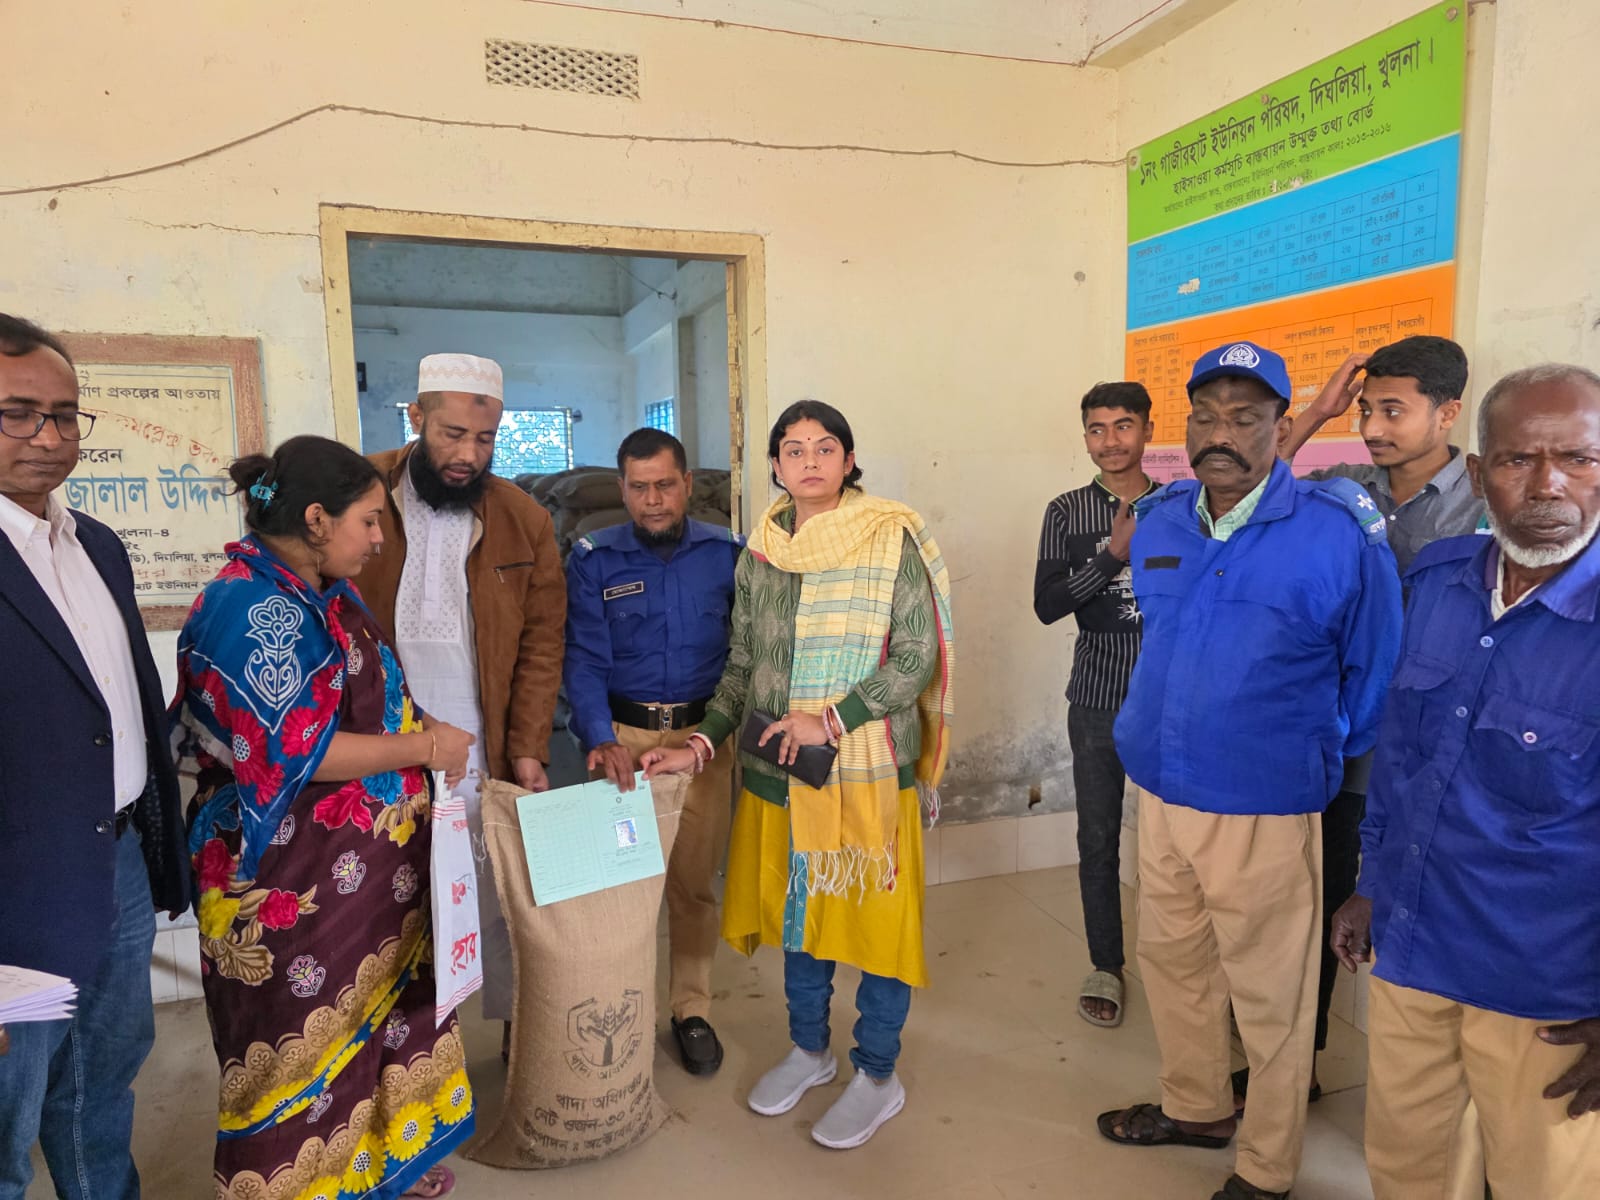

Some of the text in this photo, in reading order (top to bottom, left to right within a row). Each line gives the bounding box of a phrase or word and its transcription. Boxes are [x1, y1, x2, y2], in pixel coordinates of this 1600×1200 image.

[1160, 132, 1207, 175] গাজীরহাট
[1210, 116, 1255, 156] ইউনিয়ন
[1261, 95, 1305, 133] পরিষদ,
[1309, 64, 1372, 114] দিঘলিয়া,
[1378, 37, 1421, 89] খুলনা
[1347, 96, 1375, 127] বোর্ড
[107, 385, 160, 400] প্রকল্পের
[164, 387, 221, 401] আওতায়
[65, 464, 230, 514] জালাল উদ্দিন
